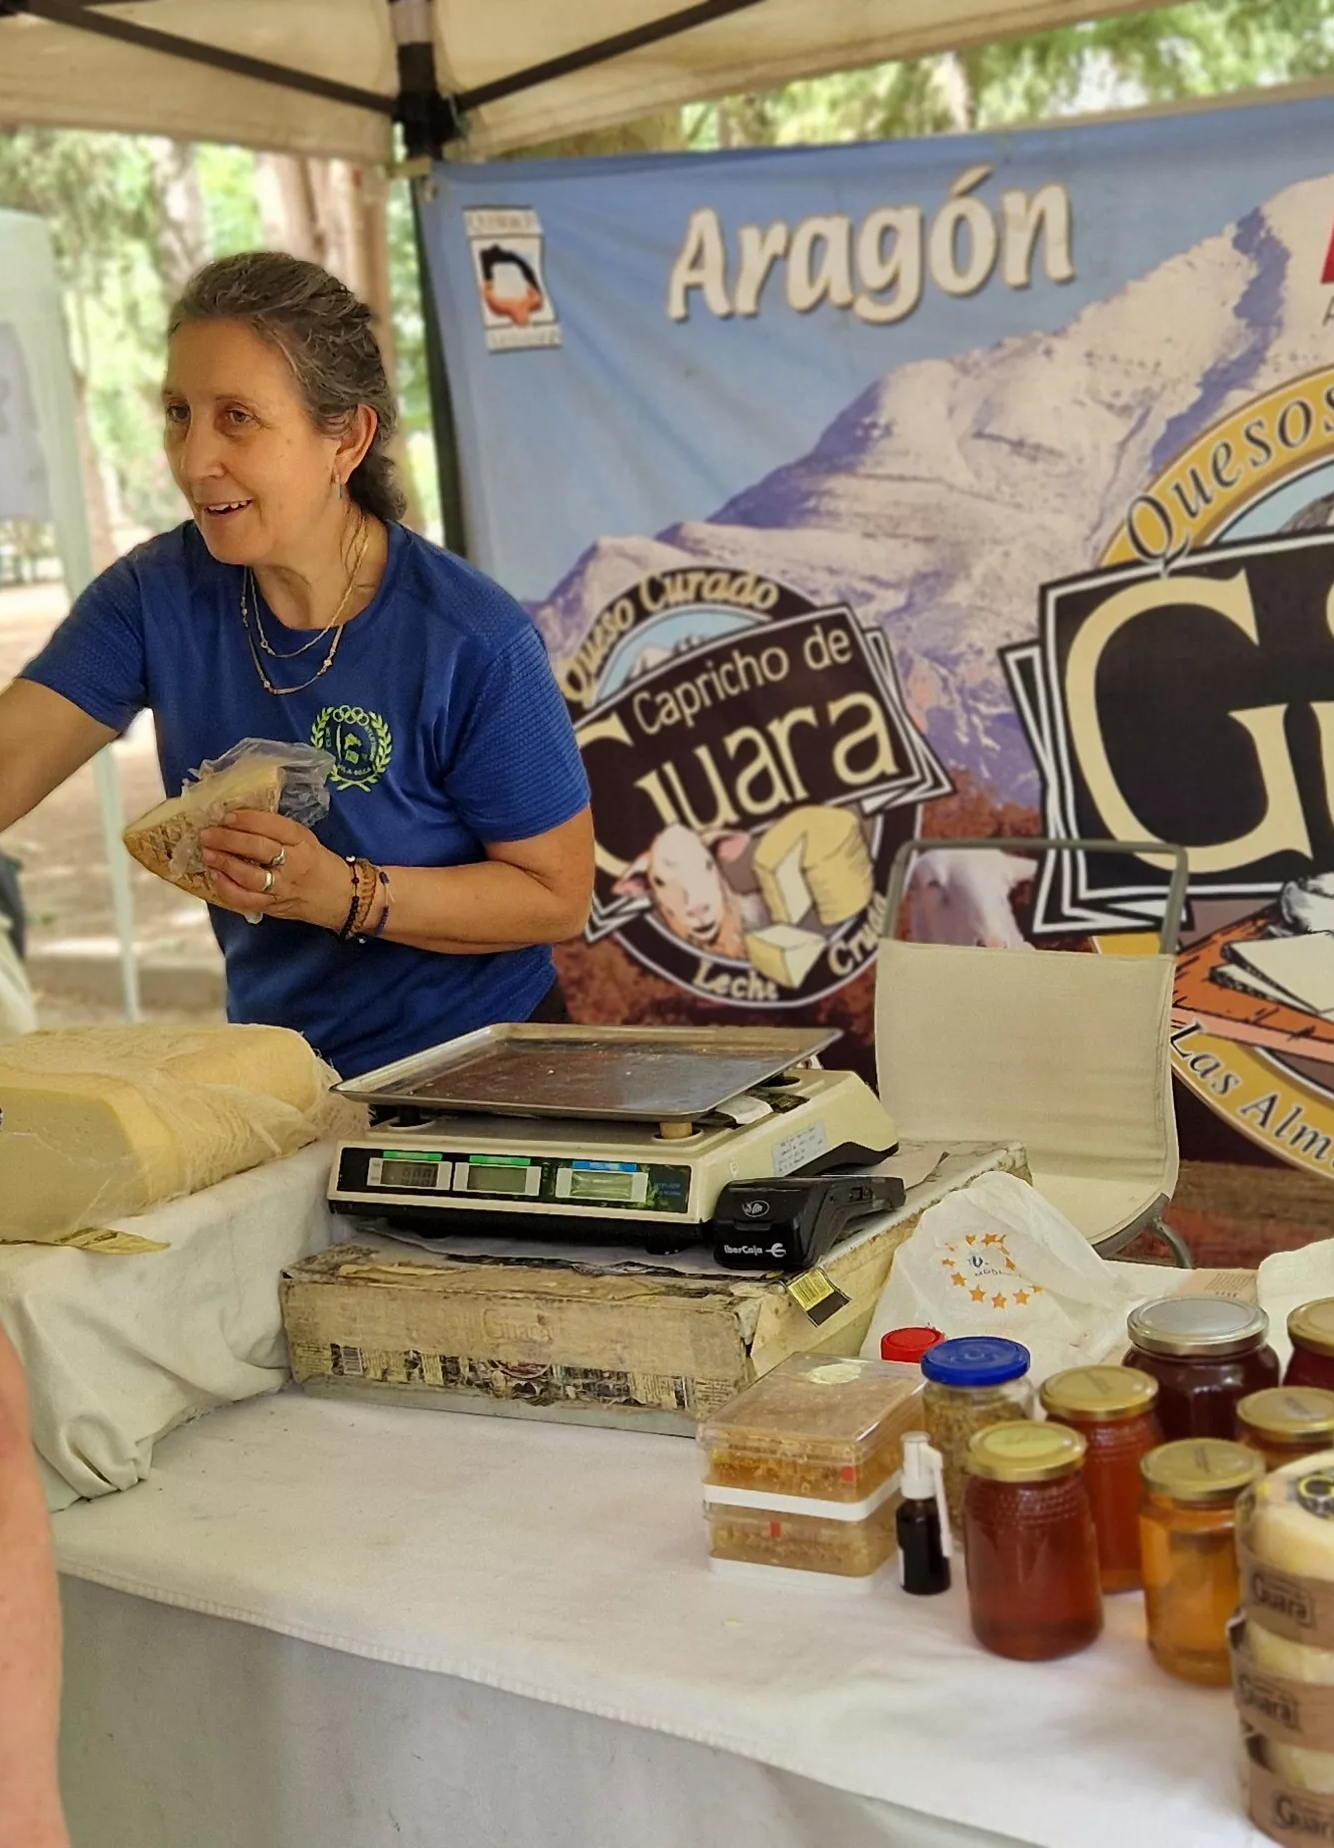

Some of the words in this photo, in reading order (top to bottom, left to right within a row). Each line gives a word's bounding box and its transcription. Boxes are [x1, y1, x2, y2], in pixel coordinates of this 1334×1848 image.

[669, 163, 1075, 325] Aragón
[559, 597, 636, 709] Queso
[638, 566, 780, 613] Curado
[632, 645, 791, 735] Capricho
[802, 623, 854, 671] de
[1169, 1021, 1238, 1096] Las
